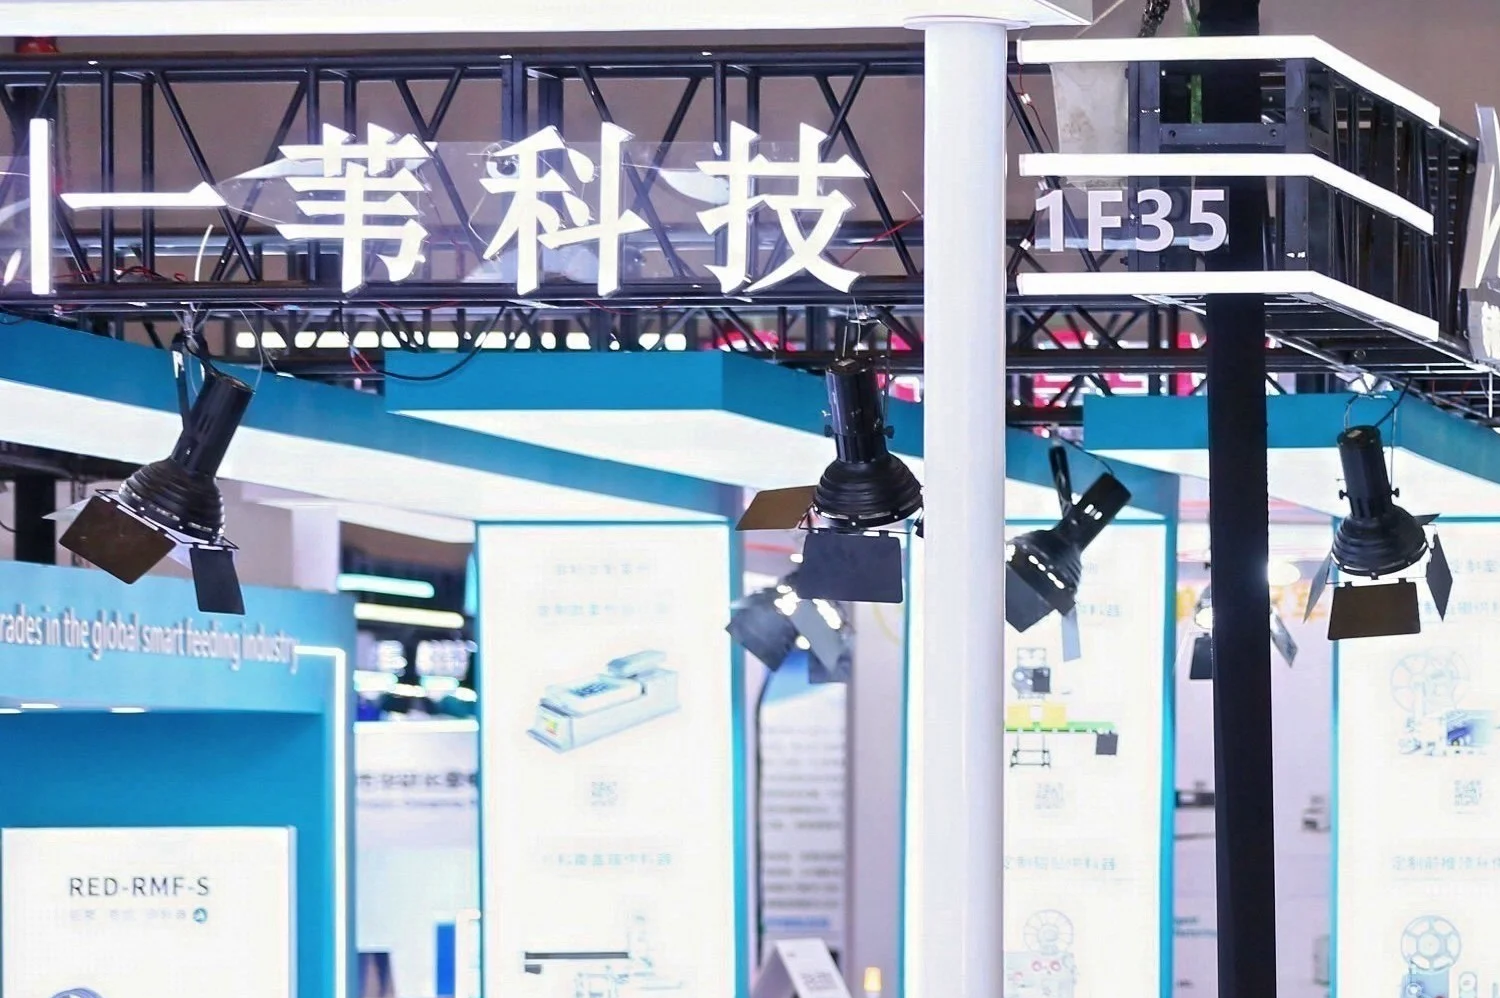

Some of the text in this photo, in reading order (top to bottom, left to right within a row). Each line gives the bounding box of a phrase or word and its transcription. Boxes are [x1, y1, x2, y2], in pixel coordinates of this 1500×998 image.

[61, 120, 870, 296] 一苇科技
[1035, 188, 1228, 252] 1F35
[45, 605, 60, 646] in
[61, 606, 89, 649] the
[91, 609, 139, 661] global
[141, 622, 184, 656] smart
[185, 617, 241, 671] feeding
[242, 621, 299, 674] industry
[69, 876, 210, 897] RED-RMF-S
